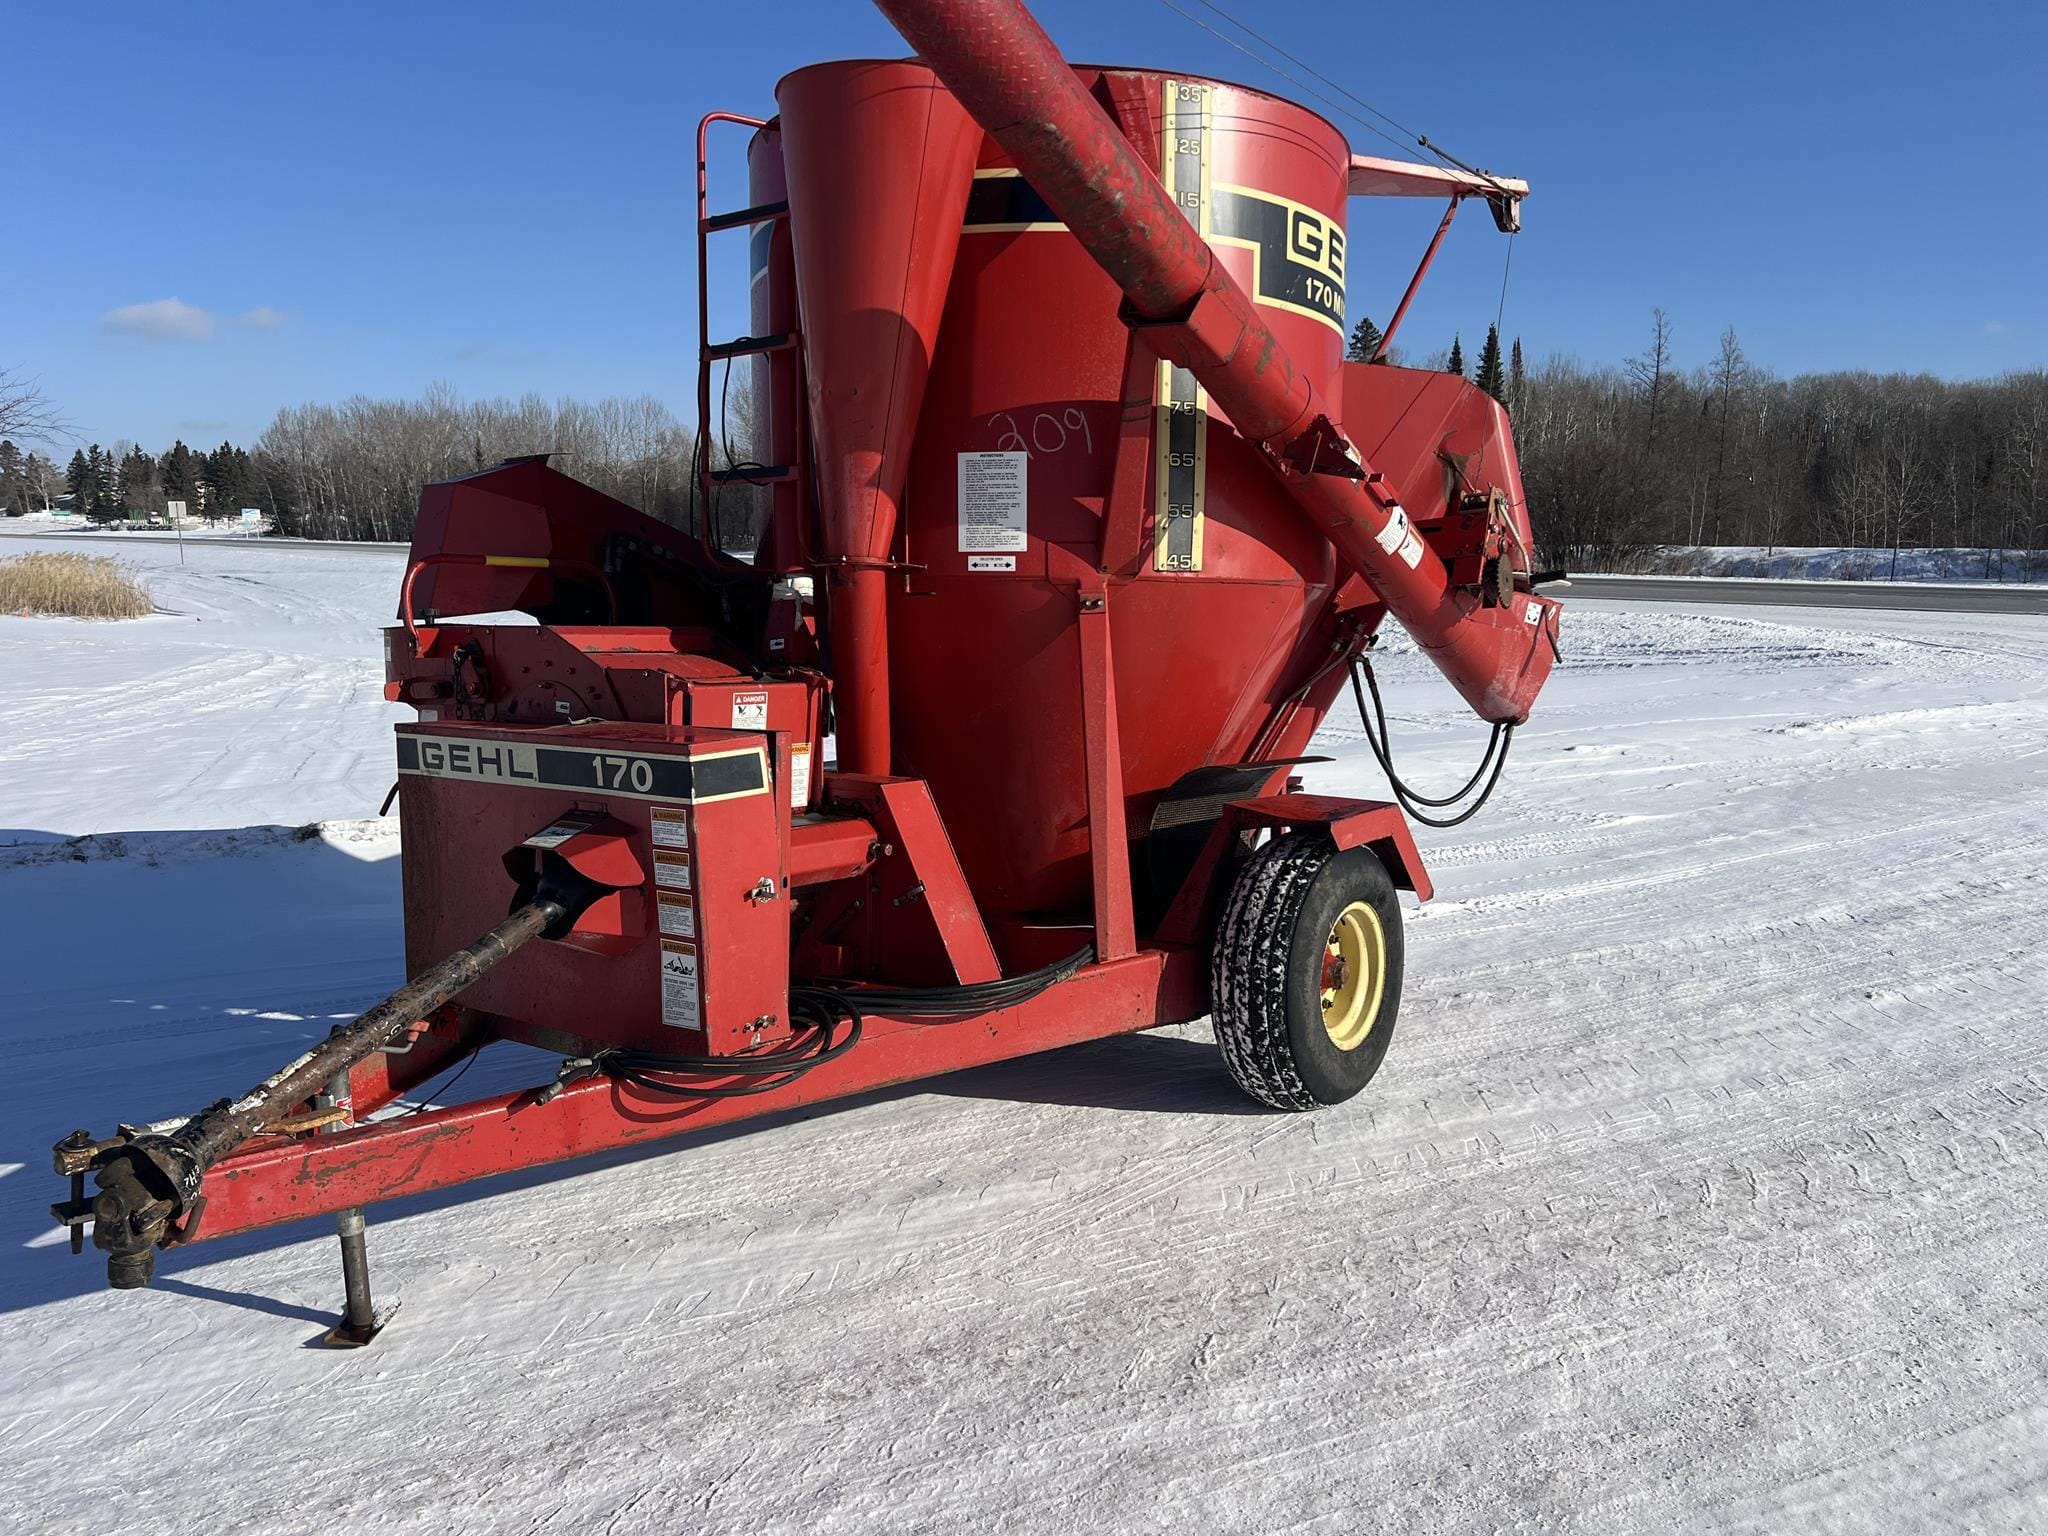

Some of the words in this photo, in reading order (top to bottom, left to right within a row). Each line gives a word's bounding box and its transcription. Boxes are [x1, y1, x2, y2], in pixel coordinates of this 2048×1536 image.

[1175, 84, 1201, 103] 135
[1175, 138, 1200, 155] 125
[1174, 191, 1199, 208] 115
[1292, 210, 1344, 280] GE
[1170, 401, 1195, 416] 75
[988, 408, 1093, 460] 209
[1169, 453, 1194, 467] 65
[1168, 504, 1193, 518] 55
[1167, 554, 1191, 569] 45
[421, 742, 534, 780] GEHL
[592, 756, 653, 792] 170
